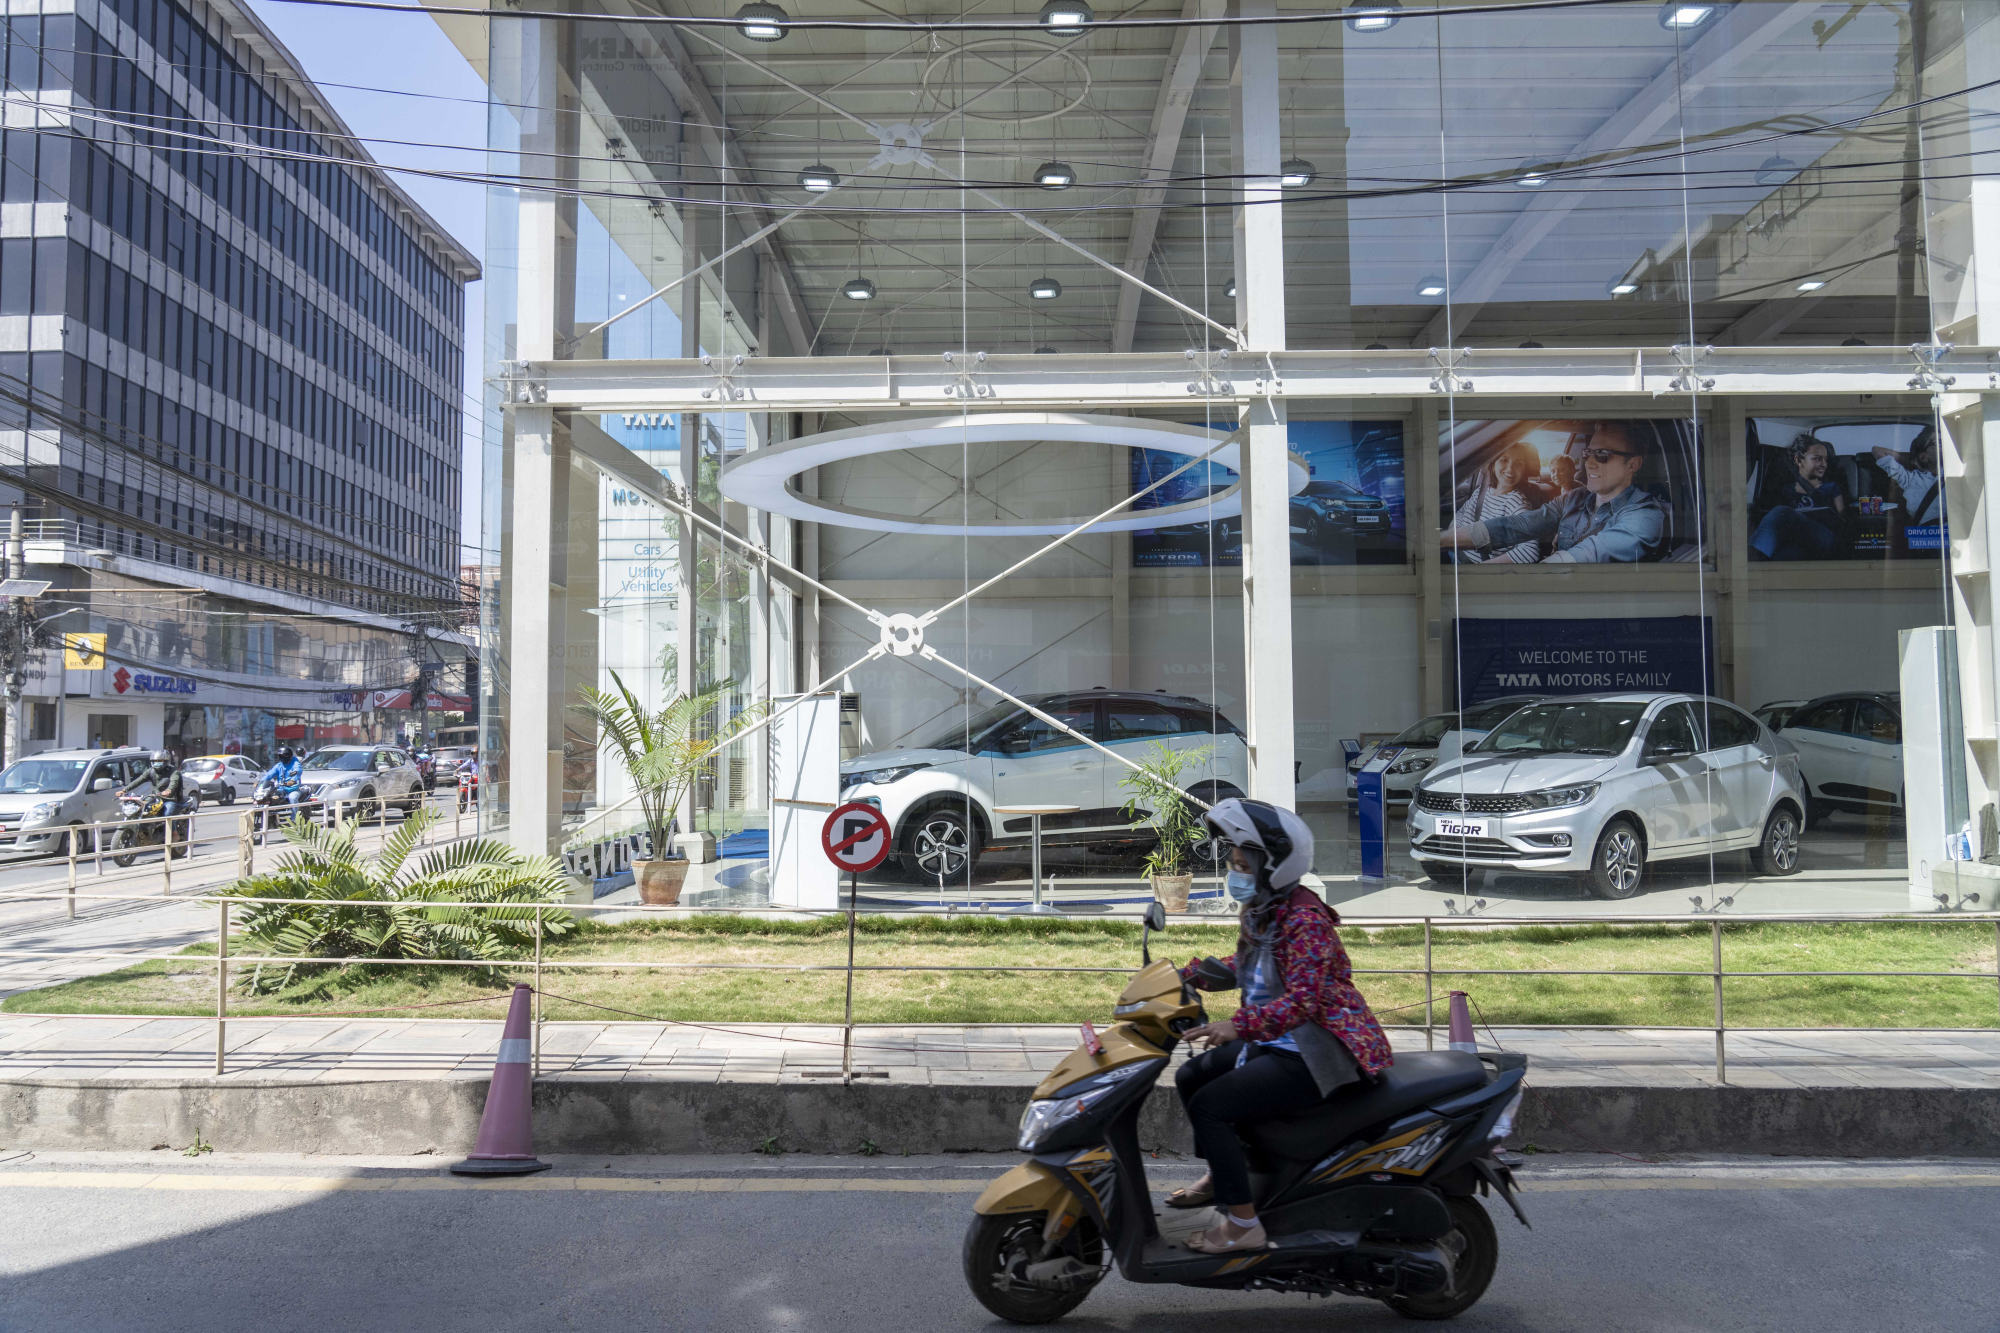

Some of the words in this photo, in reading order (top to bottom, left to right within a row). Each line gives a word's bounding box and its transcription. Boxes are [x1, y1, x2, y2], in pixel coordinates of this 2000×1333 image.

[622, 413, 675, 426] TATA
[634, 543, 661, 555] Cars
[628, 567, 666, 580] Utility
[622, 580, 673, 592] Vehicles
[1519, 651, 1593, 664] WELCOME
[1596, 651, 1615, 664] TO
[1618, 651, 1648, 664] THE
[134, 674, 197, 694] SUZUKI
[1496, 673, 1542, 687] TATA
[1547, 673, 1612, 687] MOTORS
[1616, 673, 1672, 687] FAMILY
[1441, 825, 1482, 835] TIGOR
